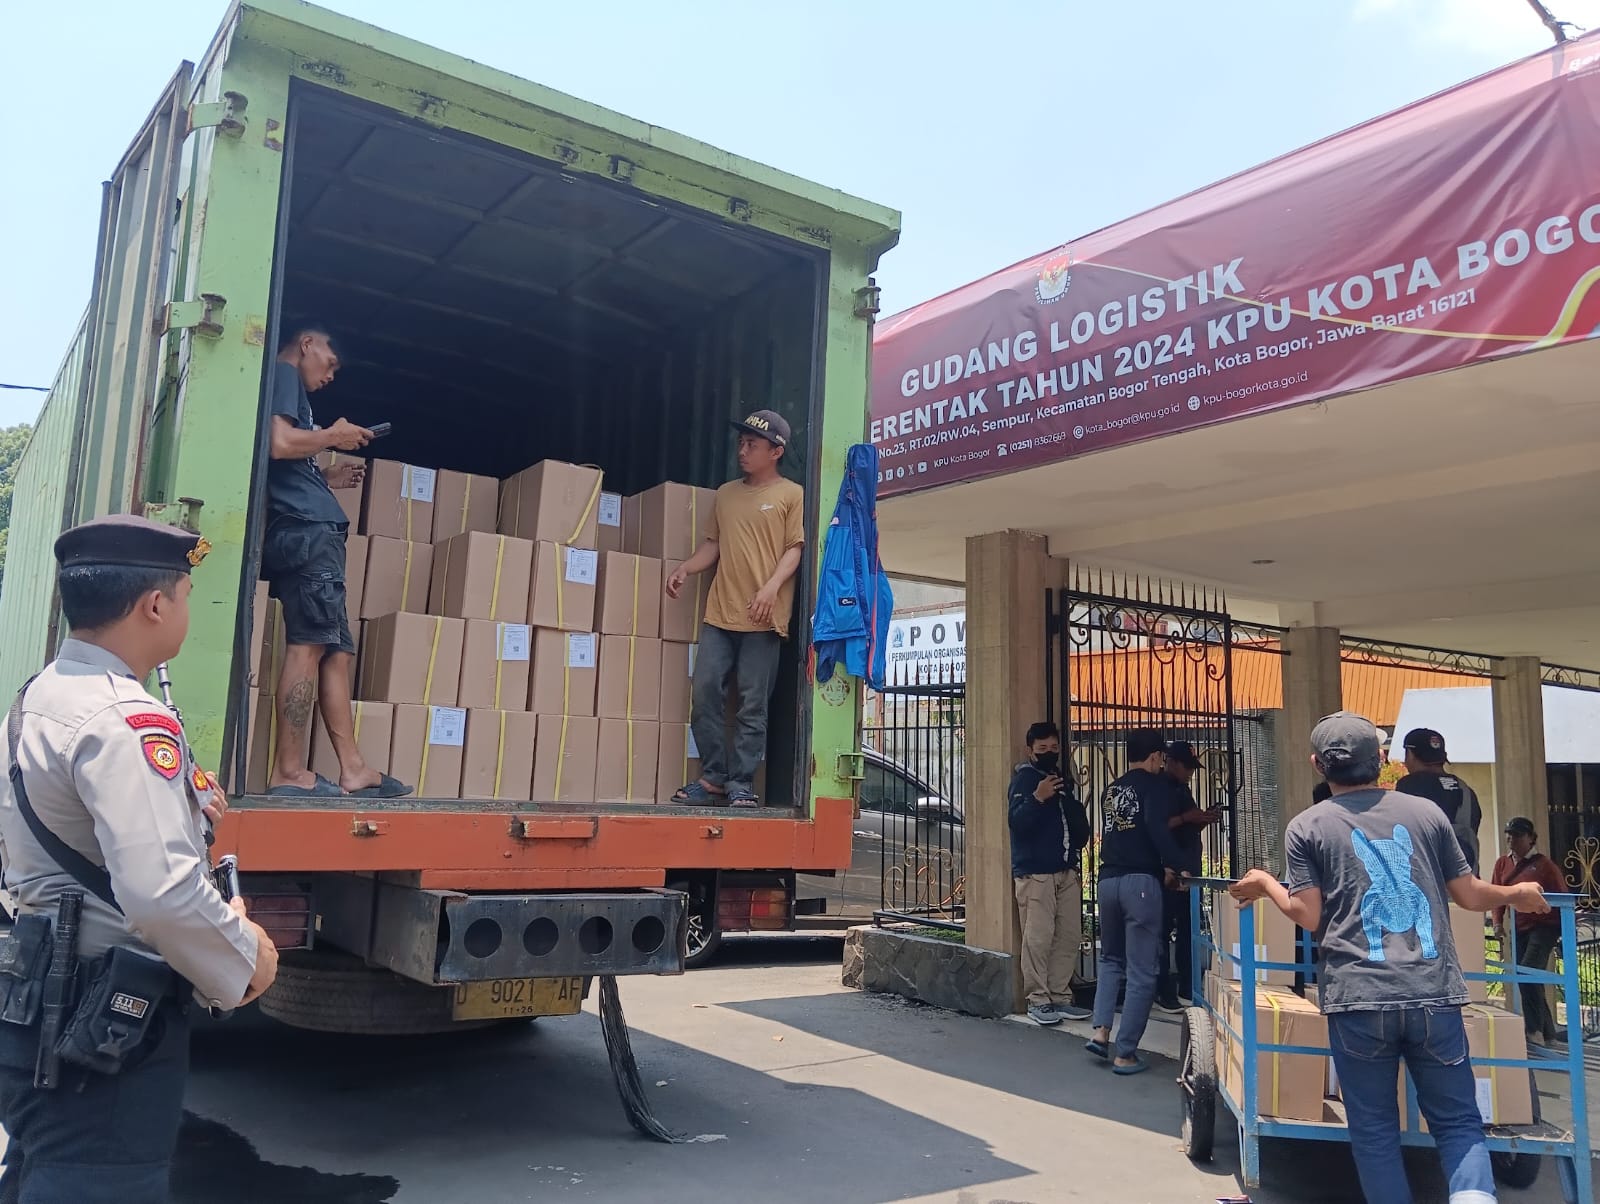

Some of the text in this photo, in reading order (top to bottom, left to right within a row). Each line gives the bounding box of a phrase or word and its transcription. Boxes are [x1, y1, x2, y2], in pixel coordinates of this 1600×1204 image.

[879, 288, 1476, 459] No.23, RT.02/RW.04, Sempur, Kecamatan Bogor Tengah, Kota Bogor, Jawa Barat 16121
[901, 257, 1245, 397] GUDANG LOGISTIK
[997, 355, 1103, 408] TAHUN
[1114, 326, 1195, 377] 2024
[1207, 297, 1290, 350] KPU
[1308, 256, 1441, 320] KOTA
[1457, 204, 1600, 280] BOGO
[933, 458, 948, 468] KPU
[950, 454, 967, 463] Kota
[968, 449, 990, 460] Bogor
[1010, 439, 1033, 453] (0251)
[1085, 404, 1180, 435] kota_bogor@kpu.go.id
[1203, 371, 1308, 406] kpu-bogorkota.go.id
[491, 979, 535, 1003] 9021
[558, 977, 580, 1002] AF
